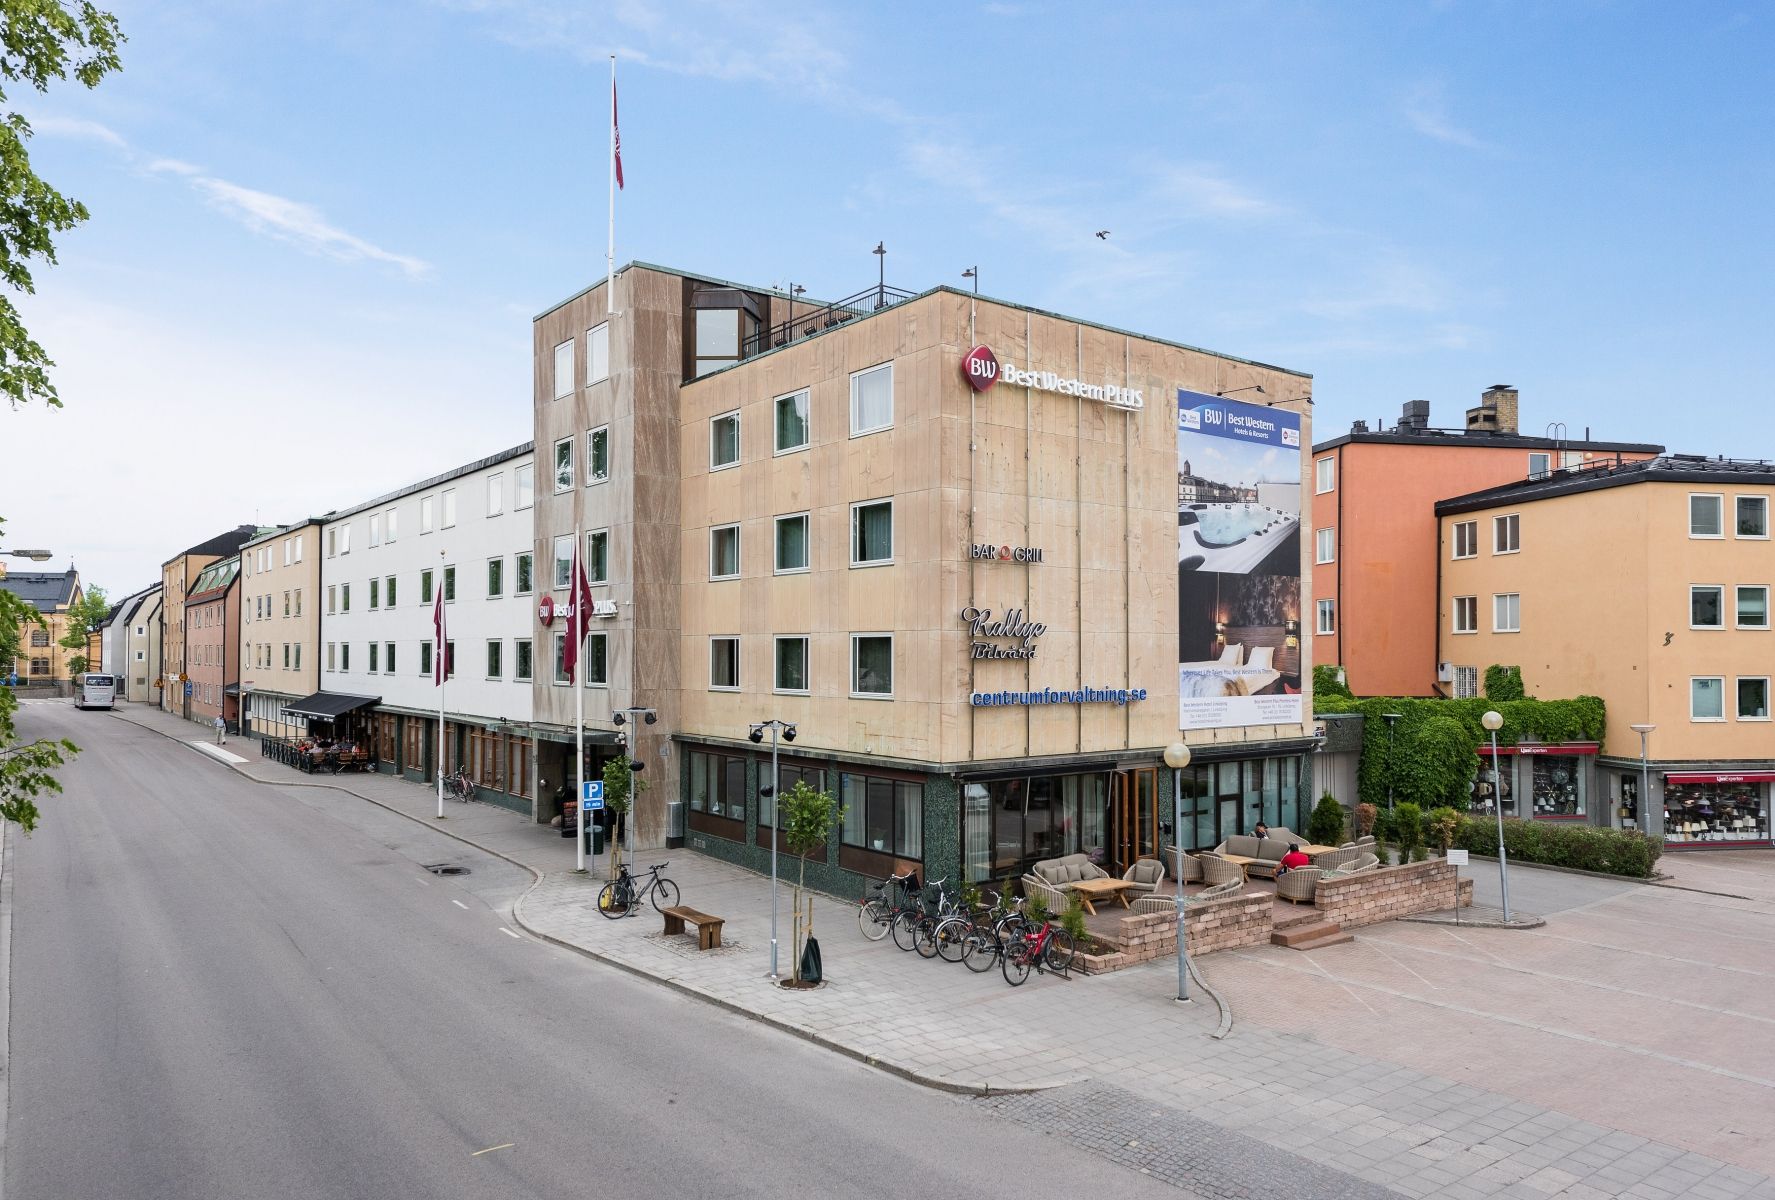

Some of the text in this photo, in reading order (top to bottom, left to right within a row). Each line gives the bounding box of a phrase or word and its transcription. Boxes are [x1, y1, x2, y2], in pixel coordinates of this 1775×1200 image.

[970, 357, 996, 379] BW
[1105, 384, 1143, 408] PLUS
[1204, 408, 1222, 425] BW
[1228, 413, 1245, 426] Best
[1234, 428, 1249, 436] Hotels
[1252, 430, 1269, 439] Resorts
[970, 543, 996, 560] BAR
[1014, 546, 1044, 563] GRILL
[962, 606, 1048, 647] Rallye
[971, 686, 1147, 706] centrumforvaltning.se
[588, 783, 599, 798] P
